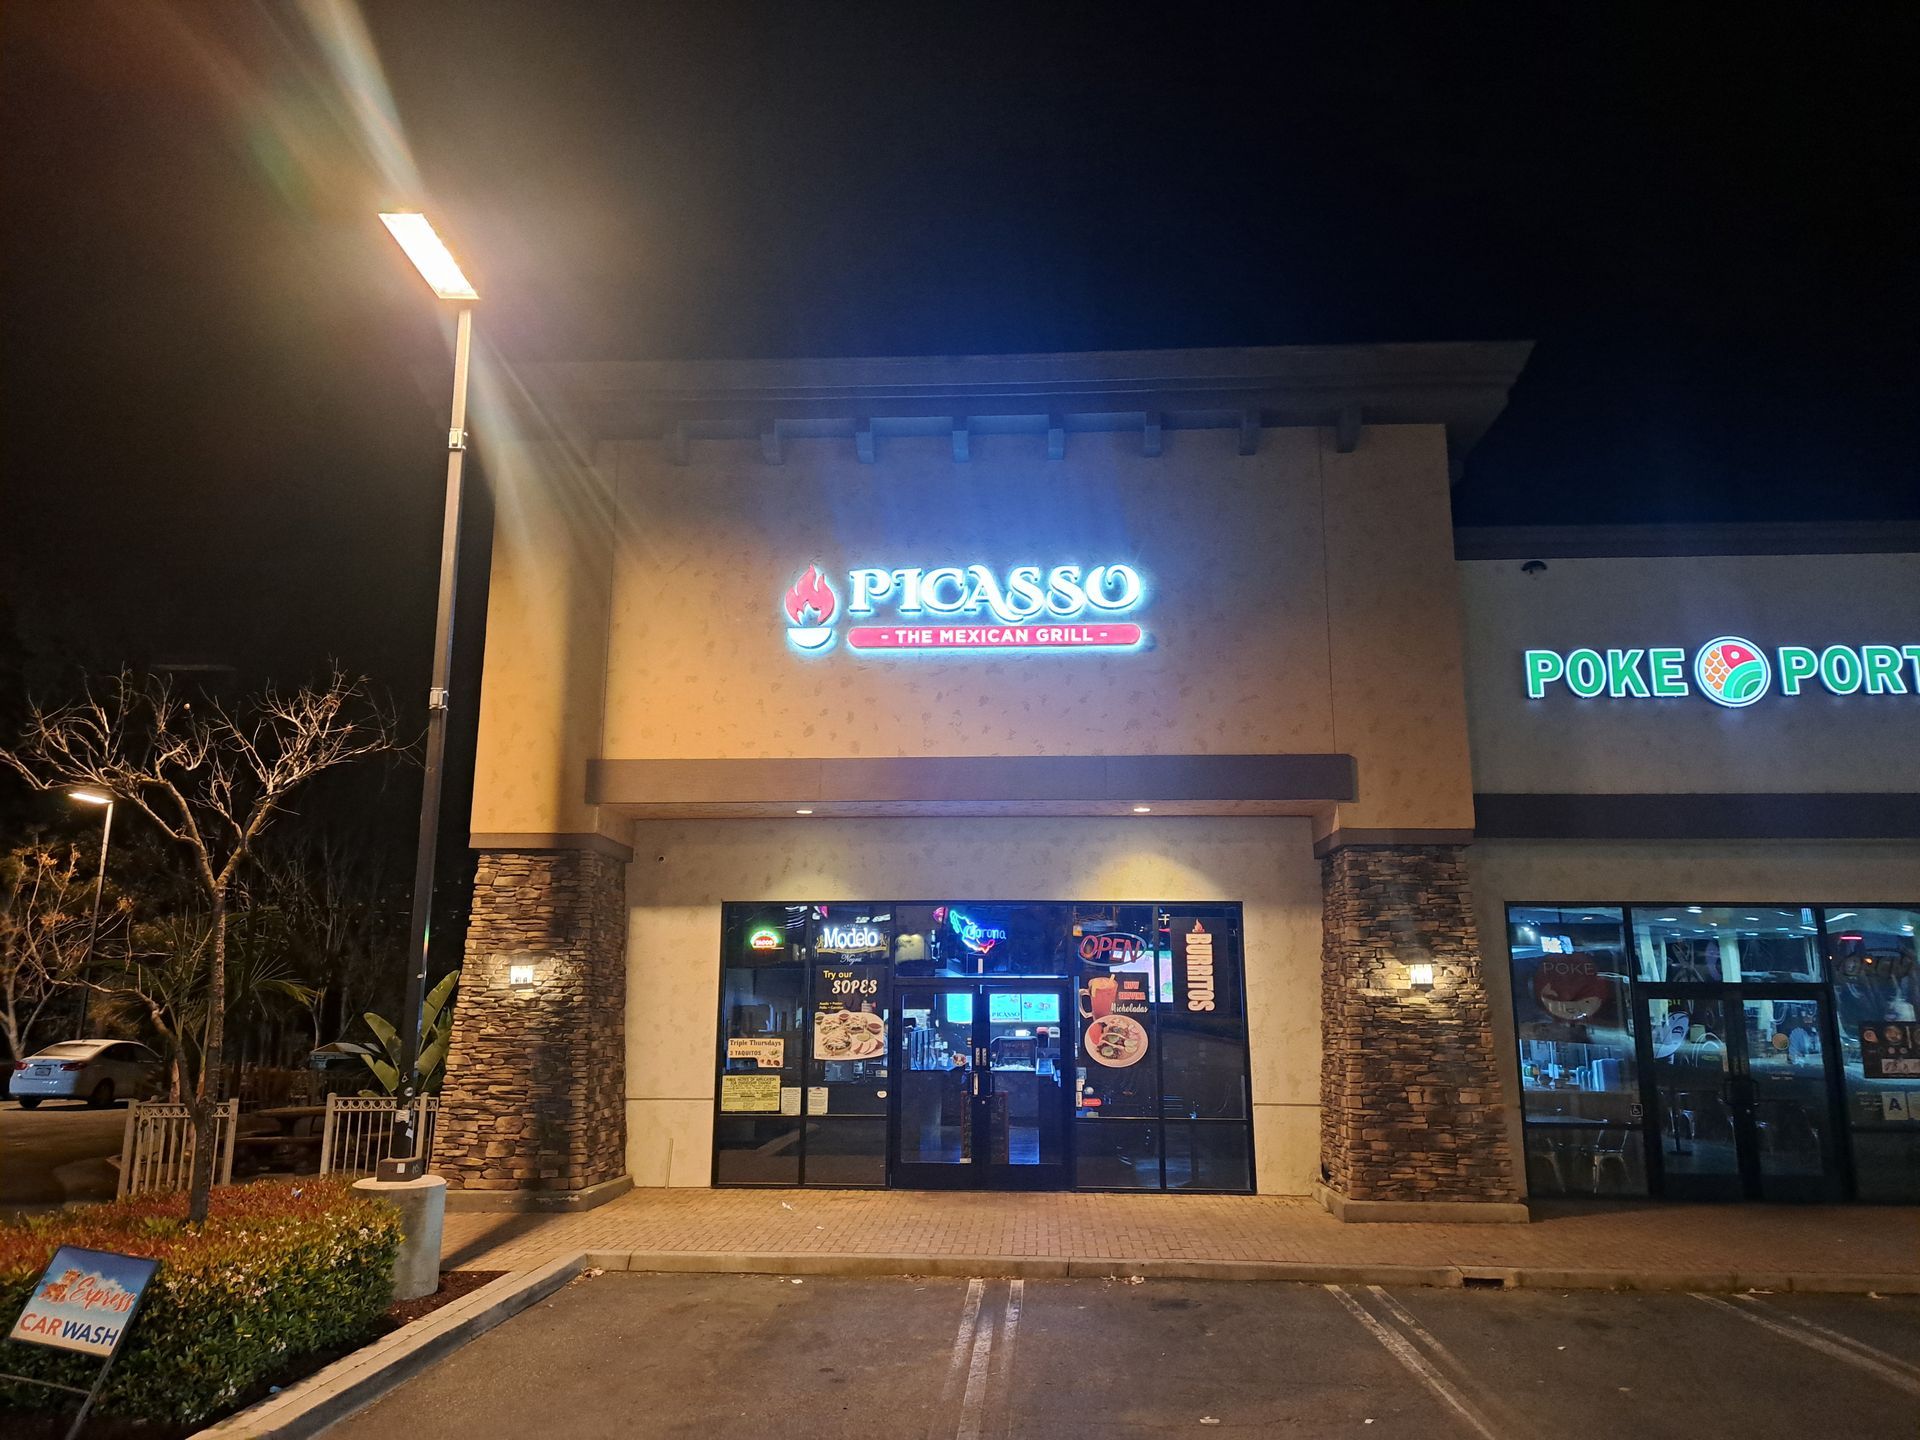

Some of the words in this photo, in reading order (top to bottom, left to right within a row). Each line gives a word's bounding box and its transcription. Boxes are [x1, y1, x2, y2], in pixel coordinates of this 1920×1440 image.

[849, 564, 1141, 623] PICASSO
[895, 629, 932, 644] THE
[939, 629, 1029, 644] MEXICAN
[1036, 628, 1093, 643] GRILL
[1525, 648, 1689, 698] POKE
[823, 927, 879, 949] Modelo
[963, 925, 1006, 940] Corona
[1080, 935, 1143, 963] OPEN
[823, 970, 836, 980] Try
[1186, 933, 1215, 1011] BURRITOS
[1543, 962, 1595, 976] POKE
[832, 979, 878, 994] SOPES
[750, 1039, 781, 1047] Thursdays
[1889, 1097, 1902, 1111] A
[69, 1277, 137, 1313] Express
[20, 1313, 63, 1336] CAR
[62, 1320, 120, 1347] WASH
